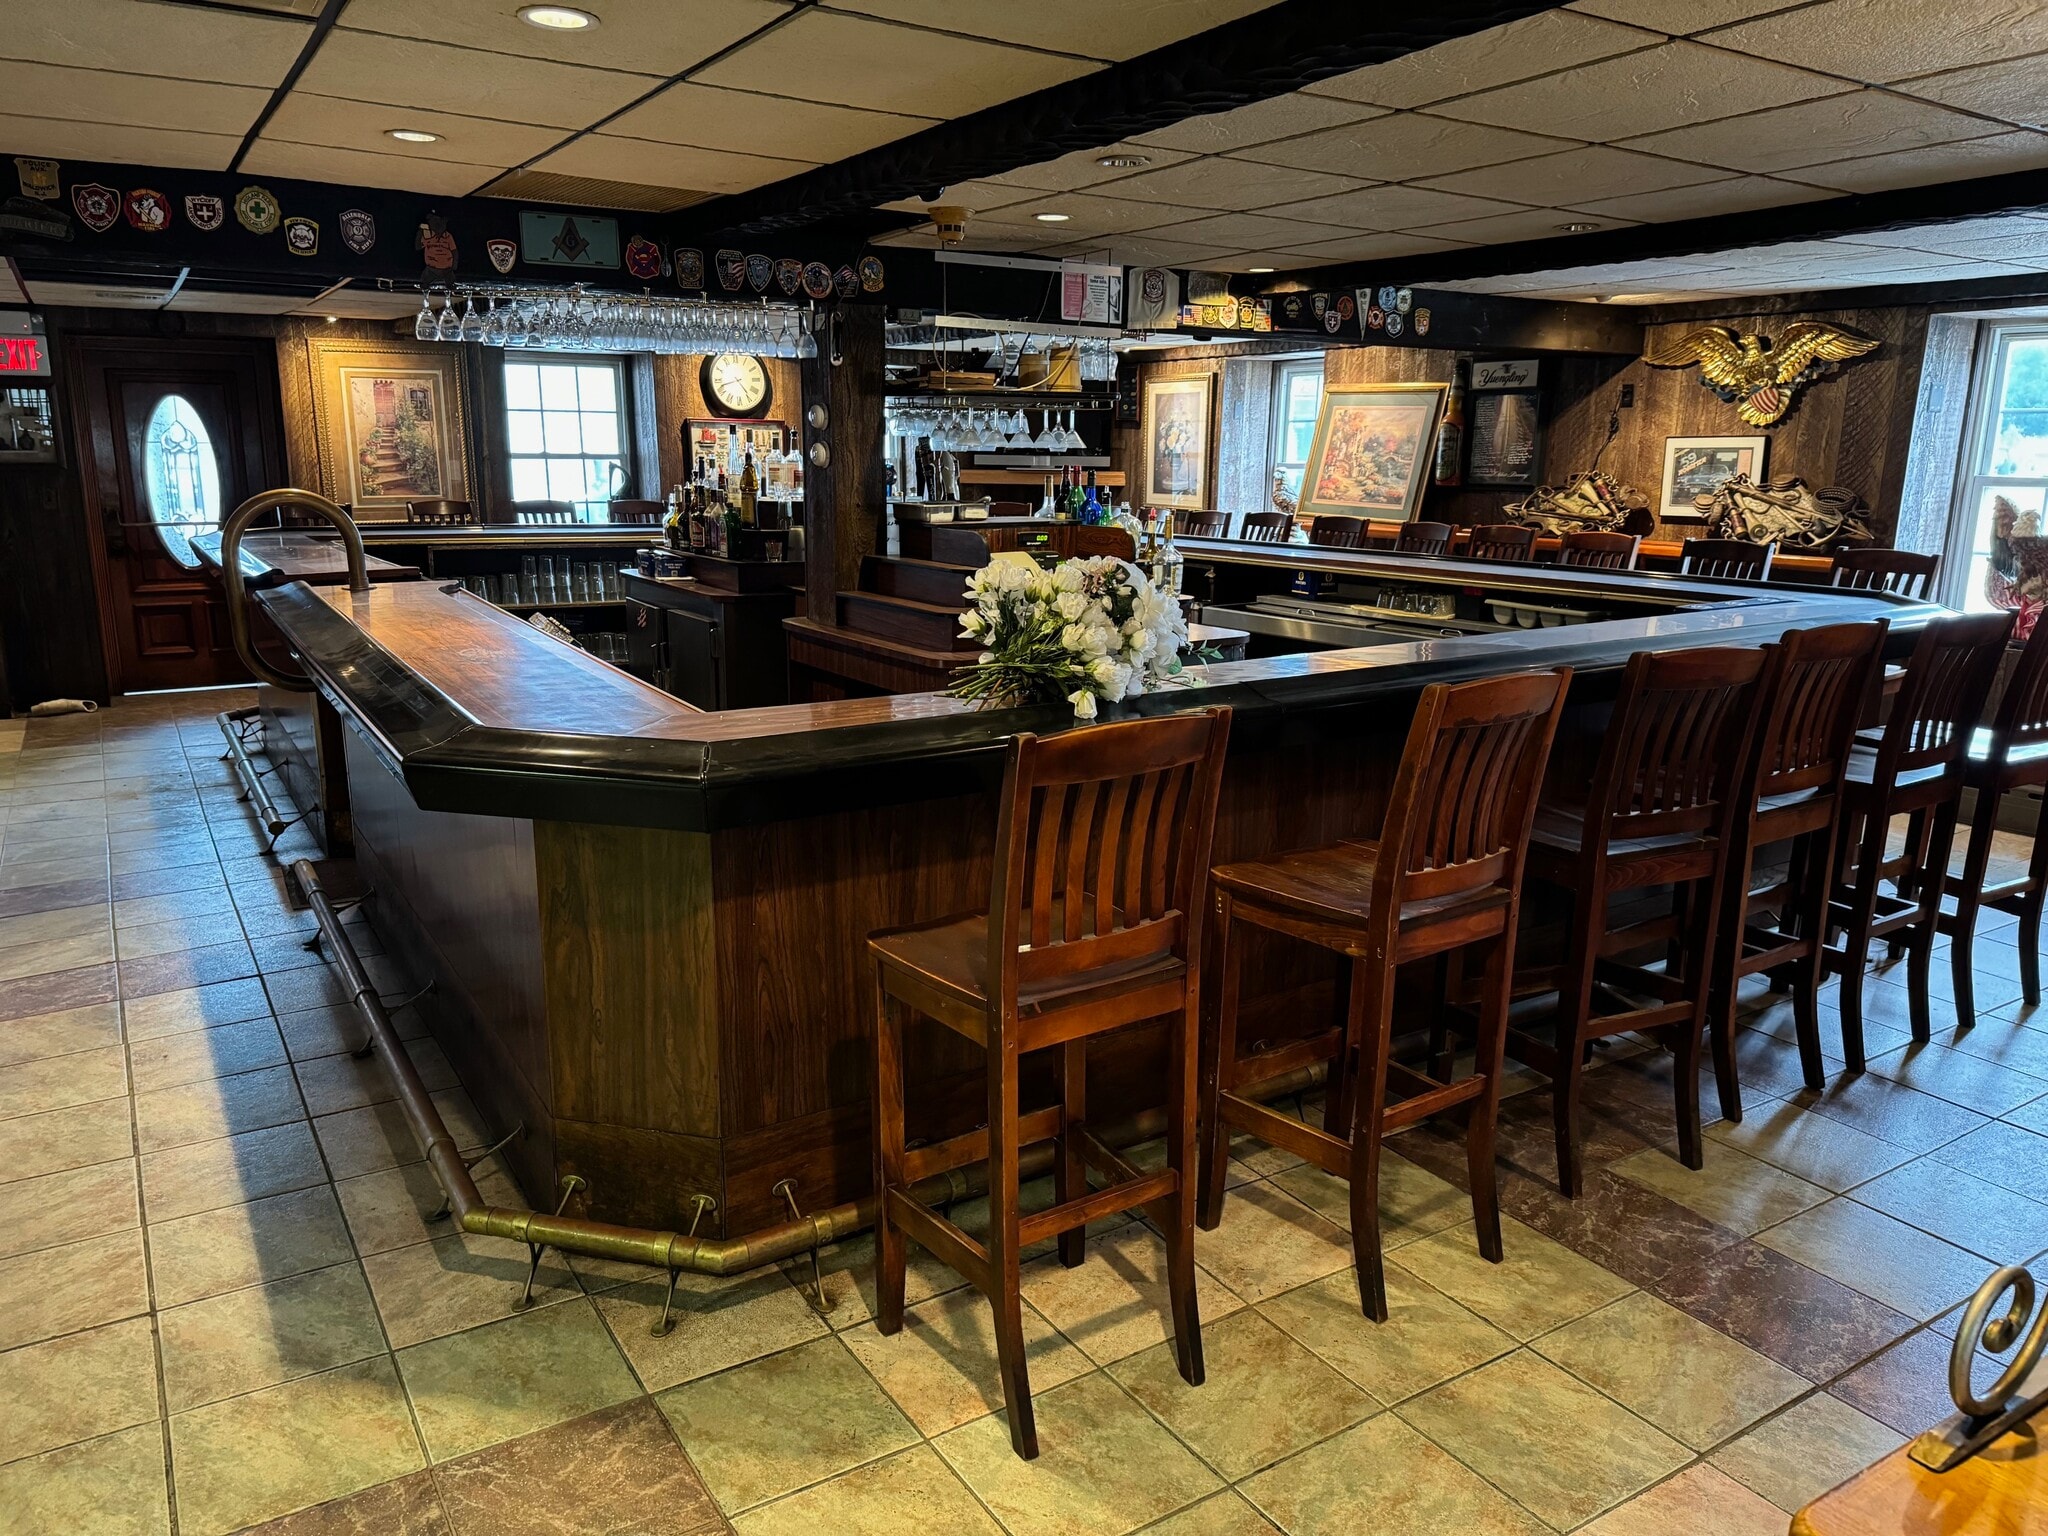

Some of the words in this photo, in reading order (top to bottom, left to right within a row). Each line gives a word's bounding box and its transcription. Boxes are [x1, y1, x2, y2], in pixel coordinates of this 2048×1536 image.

[23, 160, 51, 168] POLICE
[341, 211, 372, 222] ALLENDALE
[750, 259, 770, 268] POLICE
[1478, 368, 1529, 387] Yuengling
[1679, 452, 1697, 468] 59
